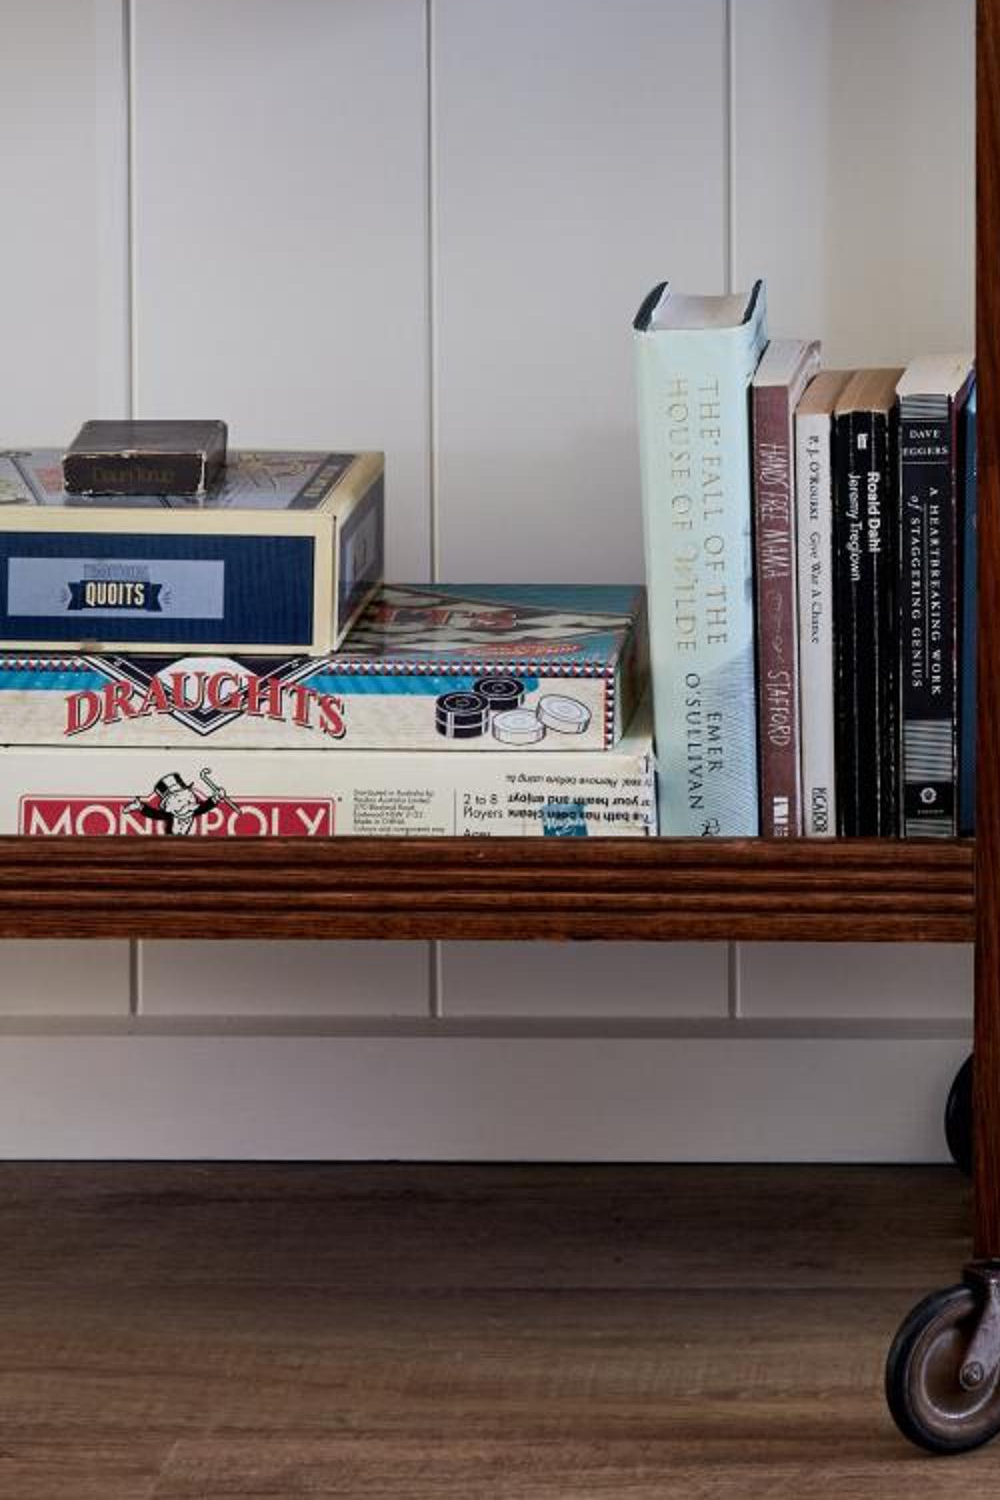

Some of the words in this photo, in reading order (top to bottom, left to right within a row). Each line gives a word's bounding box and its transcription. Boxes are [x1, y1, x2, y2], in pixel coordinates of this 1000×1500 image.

[668, 377, 692, 481] HOUSE
[699, 379, 721, 440] THE
[909, 429, 941, 440] DAVE
[701, 453, 724, 522] FALL
[760, 491, 789, 526] FREE
[845, 471, 862, 520] Jeremy
[867, 471, 882, 515] Roald
[907, 495, 924, 513] of
[929, 486, 940, 497] A
[671, 493, 693, 531] OF
[703, 533, 726, 573] OF
[761, 527, 791, 580] MAMA
[809, 531, 822, 561] Give
[846, 521, 864, 582] Treglown
[868, 516, 882, 554] Dahl
[810, 562, 822, 587] War
[910, 517, 922, 620] STAGGERING
[929, 504, 942, 642] HEARTBREAKING
[84, 582, 146, 608] QUOITS
[674, 541, 699, 652] WILDE
[811, 587, 822, 600] A
[705, 585, 728, 646] THE
[811, 601, 824, 646] Chance
[911, 627, 924, 688] GENIUS
[931, 649, 942, 696] WORK
[63, 671, 348, 739] DRAUGHTS
[765, 670, 792, 747] STAFFORD
[684, 672, 704, 811] O'SULLIVAN
[705, 711, 724, 774] EMER
[463, 794, 470, 806] 2
[475, 795, 488, 806] to
[490, 794, 499, 806] 8
[545, 773, 576, 786] before
[547, 794, 571, 807] and
[611, 794, 639, 807] your
[29, 803, 327, 836] MONPOLY
[463, 805, 503, 821] Players
[602, 810, 630, 823] bath
